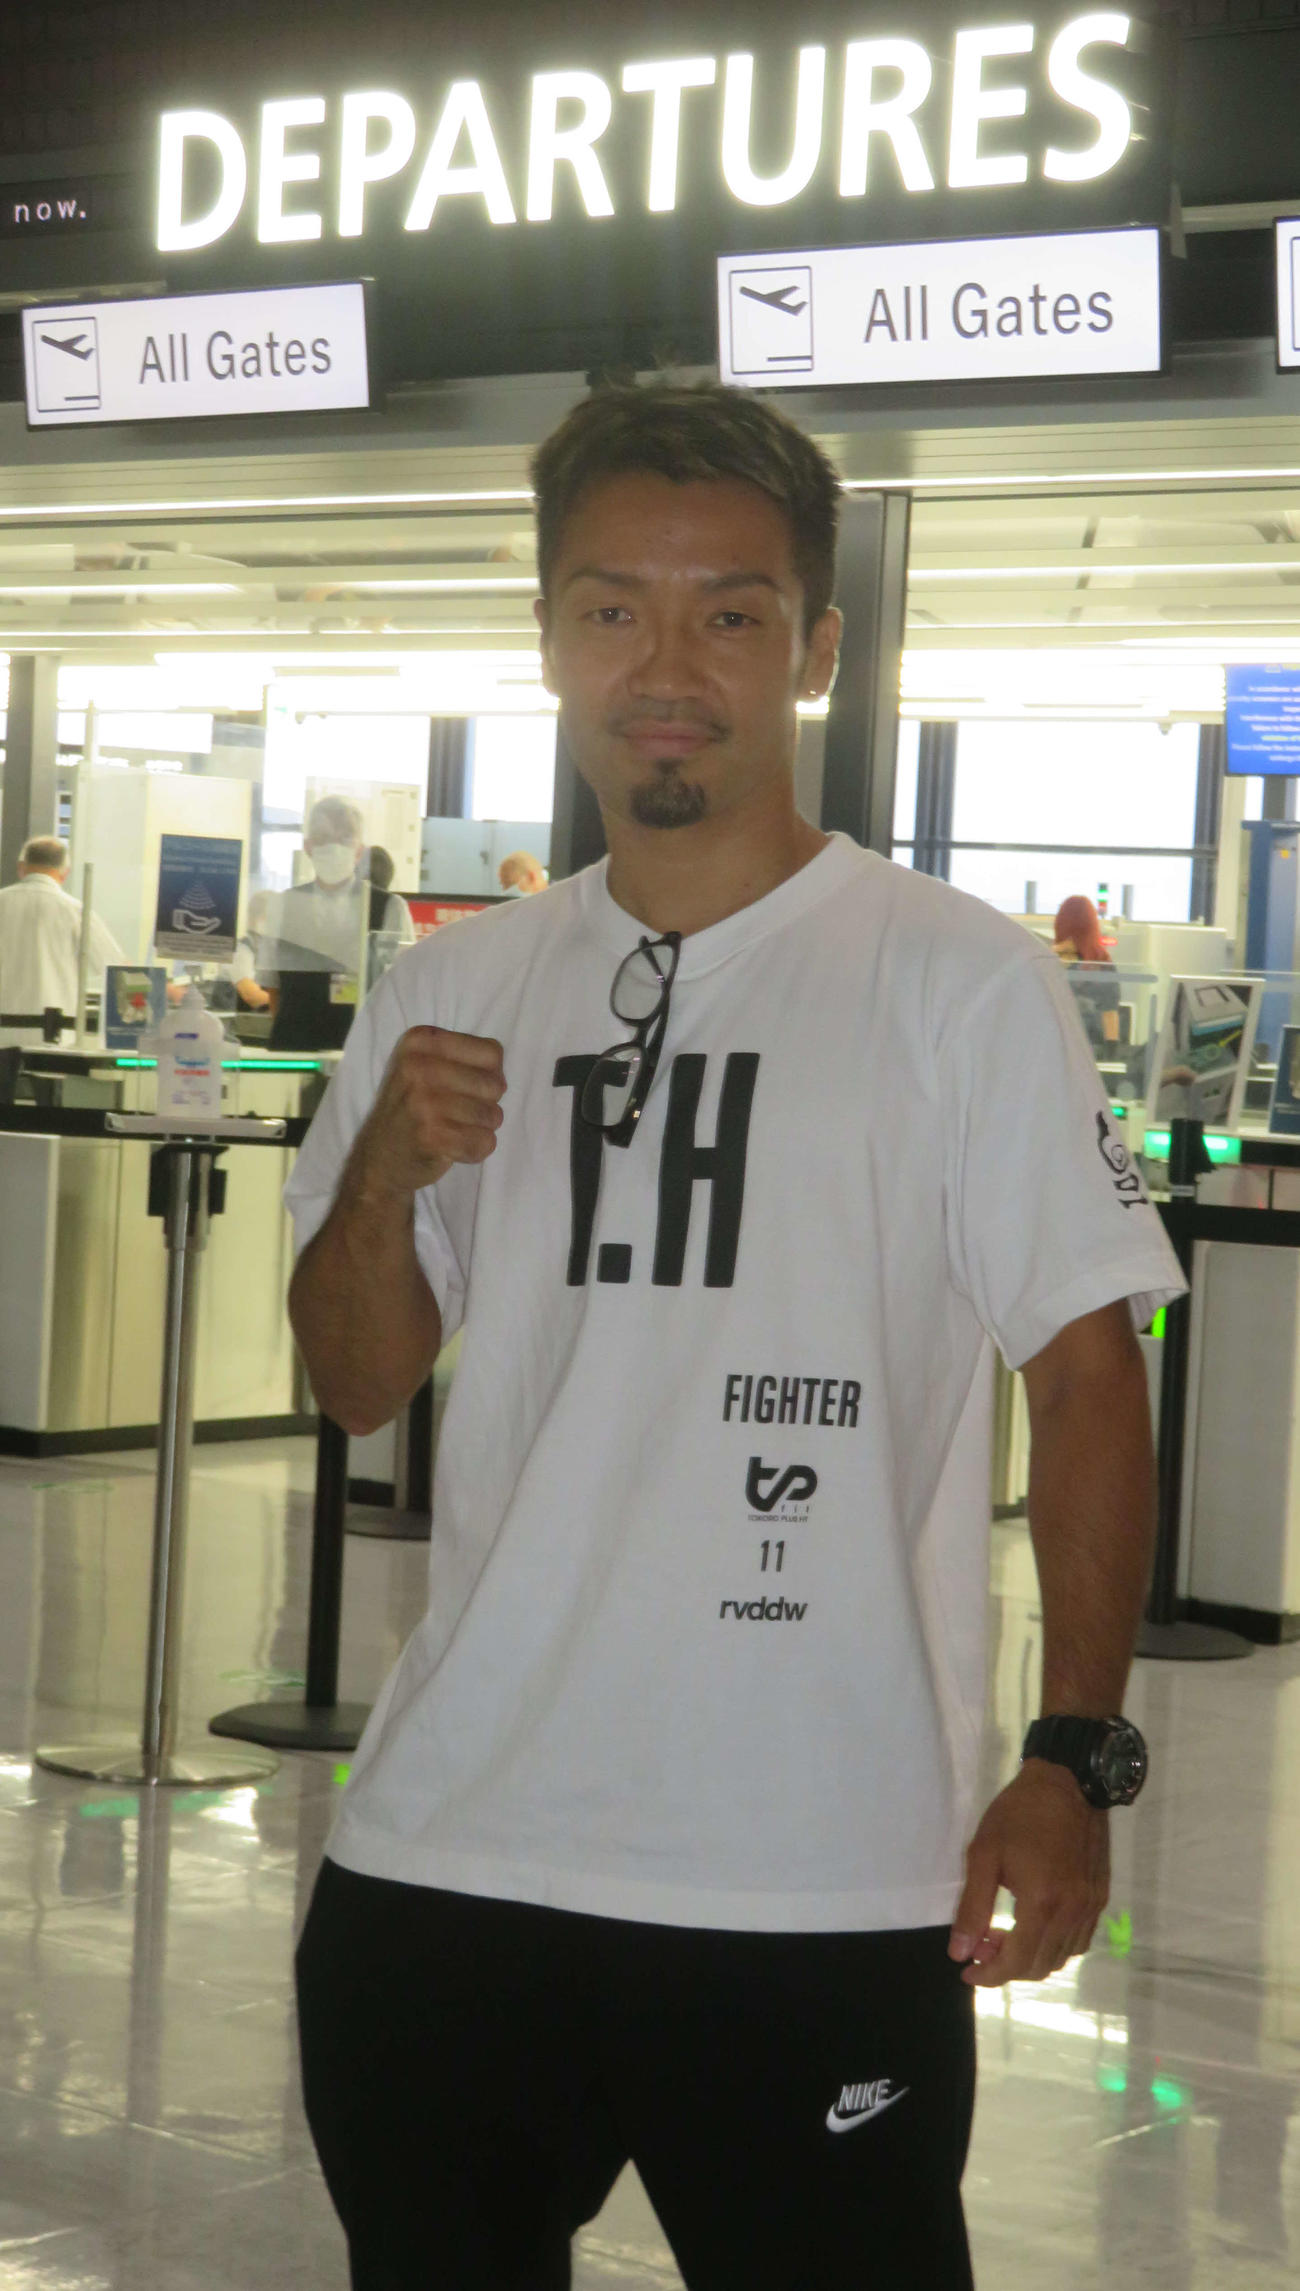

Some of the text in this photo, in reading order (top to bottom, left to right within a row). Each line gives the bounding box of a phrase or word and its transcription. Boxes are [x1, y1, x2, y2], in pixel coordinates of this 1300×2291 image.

[155, 12, 1133, 254] DEPARTURES
[14, 200, 87, 223] now.
[864, 282, 1113, 344] All Gates
[139, 330, 331, 384] All Gates
[722, 1374, 862, 1428] FIGHTER
[760, 1539, 785, 1573] 11
[719, 1596, 809, 1622] rvddw
[837, 2078, 891, 2112] NIKE
